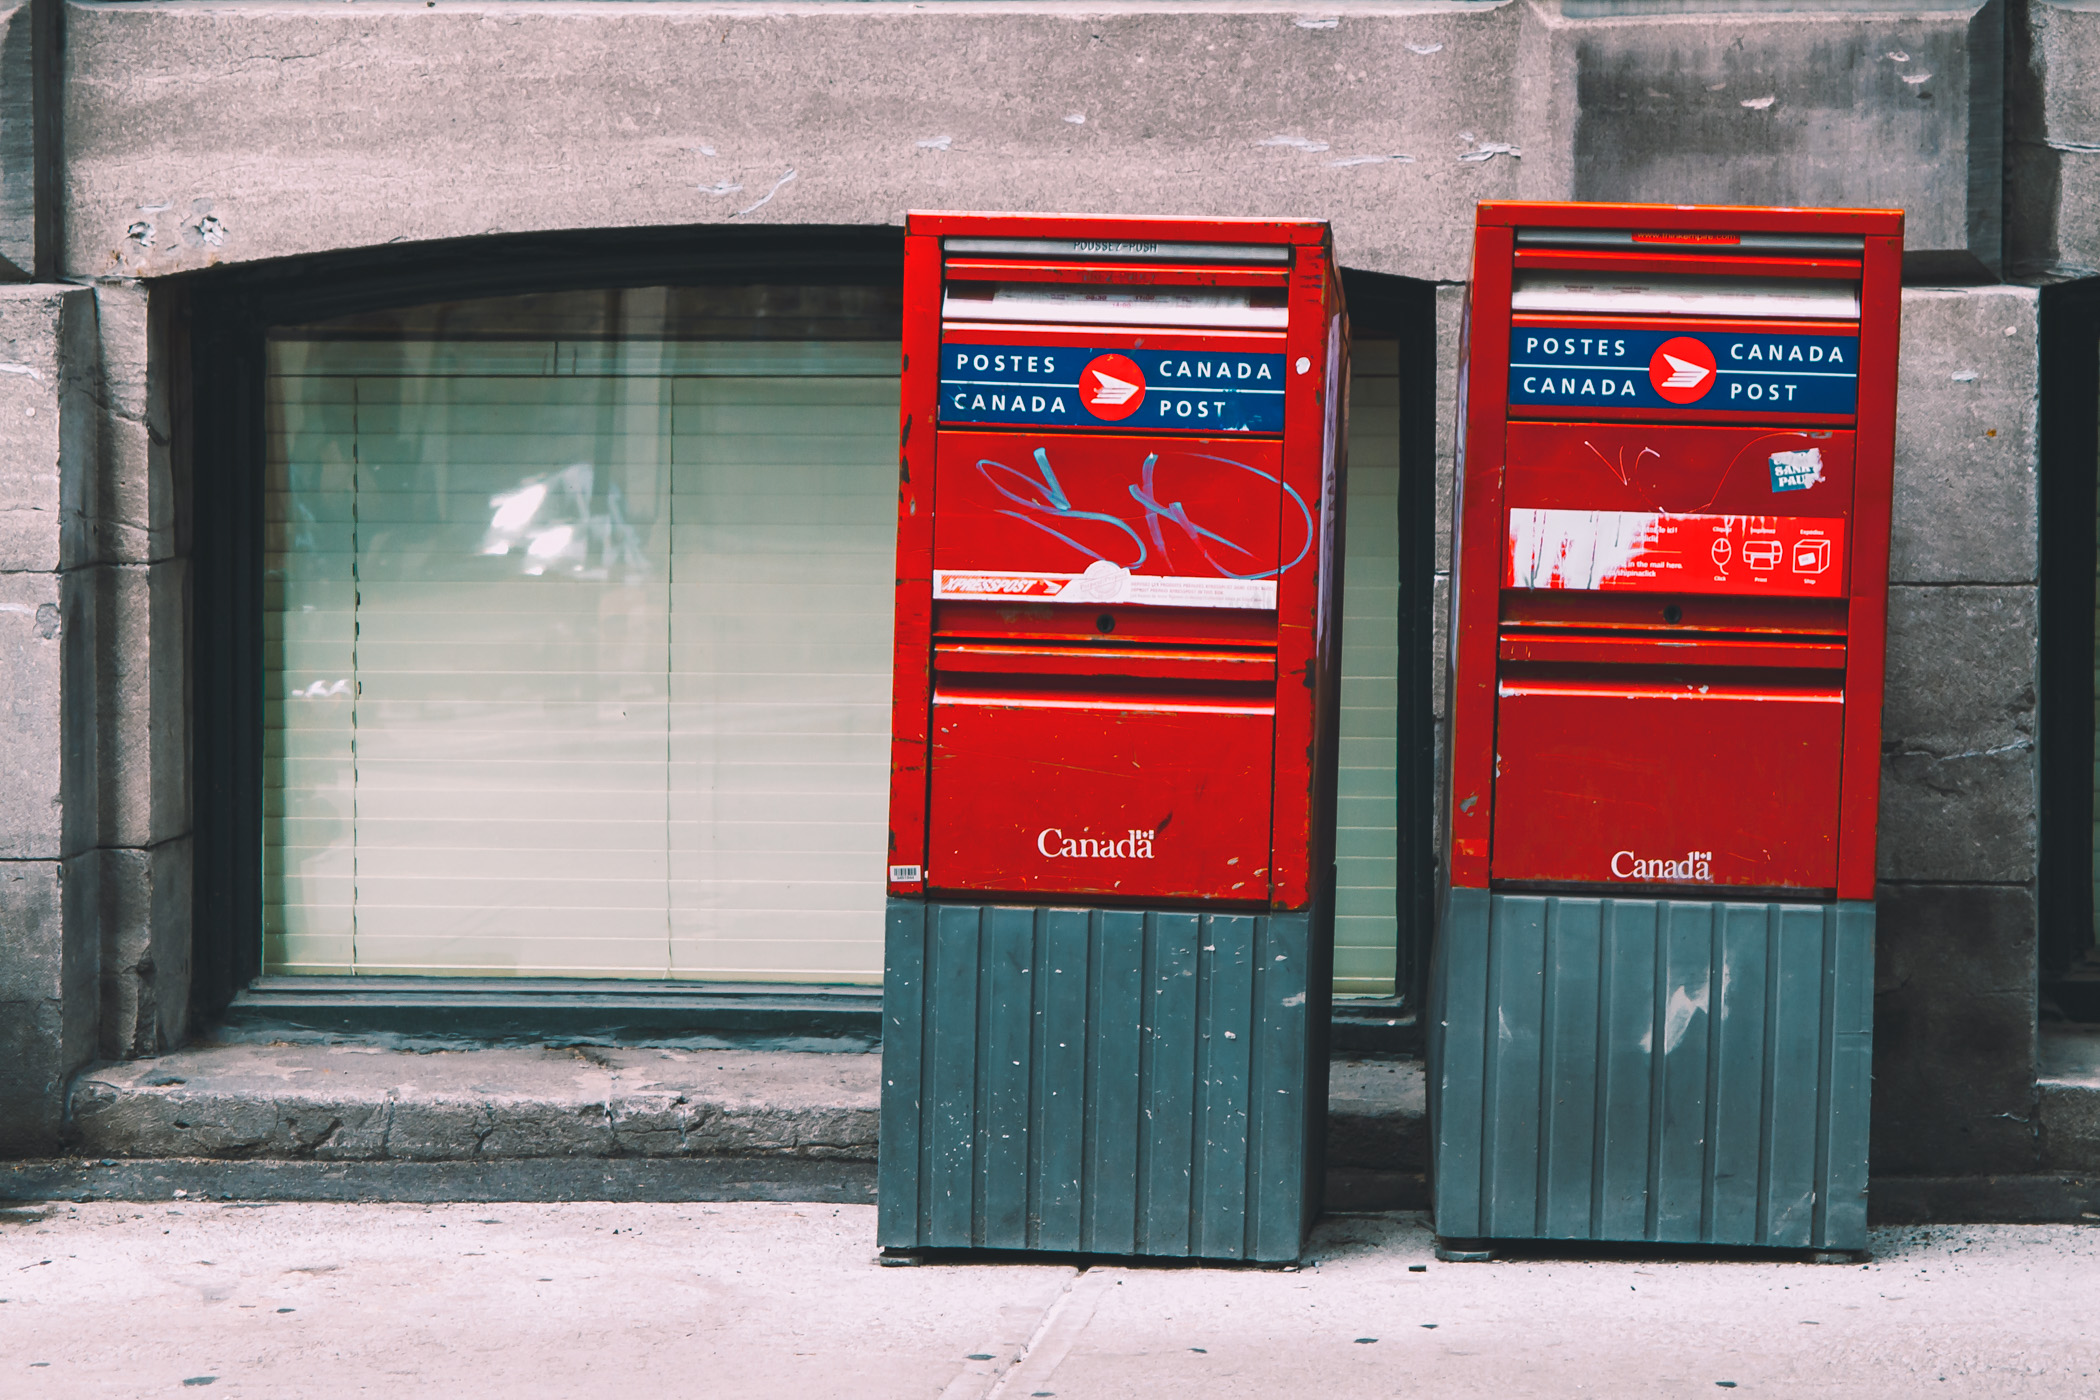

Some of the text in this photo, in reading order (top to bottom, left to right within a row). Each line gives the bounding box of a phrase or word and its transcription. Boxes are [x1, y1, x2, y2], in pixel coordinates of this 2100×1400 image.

[1527, 337, 1626, 357] POSTES
[1731, 343, 1844, 363] CANADA
[957, 353, 1055, 374] POSTES
[1160, 360, 1272, 380] CANADA
[1523, 376, 1636, 397] CANADA
[1731, 382, 1798, 401] POST
[953, 393, 1066, 414] CANADA
[1160, 399, 1226, 418] POST
[1666, 561, 1683, 569] here.
[946, 577, 1038, 593] XPRESSPOST
[1038, 828, 1155, 859] Canada
[1611, 850, 1711, 880] Canada
